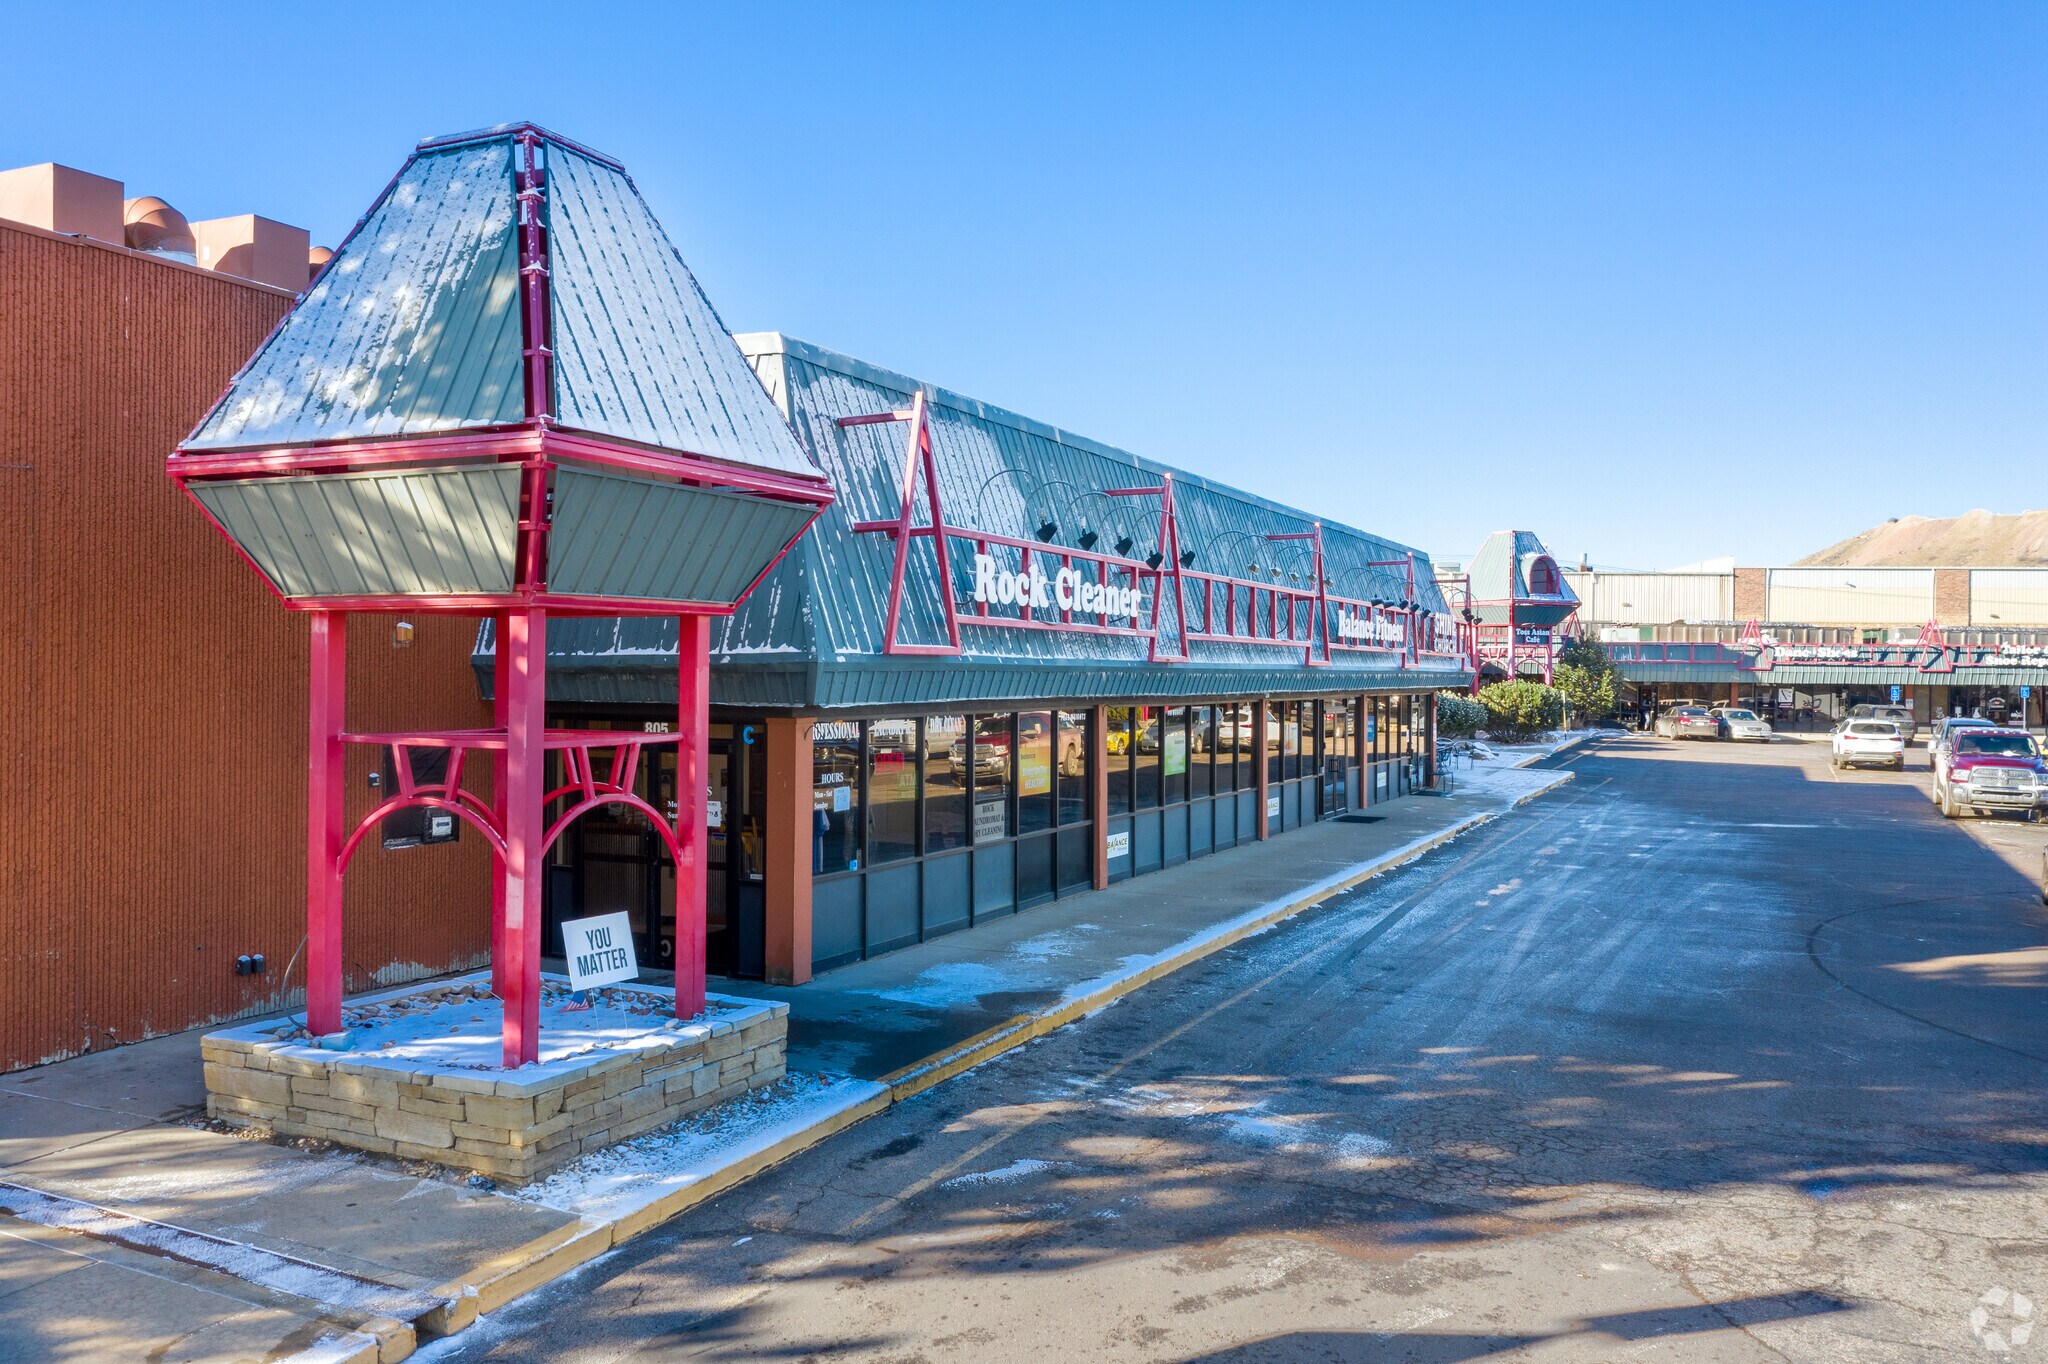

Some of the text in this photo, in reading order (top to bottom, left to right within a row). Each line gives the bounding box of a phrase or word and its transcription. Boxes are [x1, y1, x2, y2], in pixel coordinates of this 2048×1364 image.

[974, 553, 1141, 617] Rock Cleaner
[1338, 610, 1404, 642] Balance Fitness
[1531, 628, 1550, 636] Asian
[645, 722, 669, 733] 805
[821, 772, 844, 784] HOURS
[667, 800, 678, 808] Mo
[982, 804, 995, 813] ROCK
[982, 825, 1004, 836] CLEANING
[586, 927, 612, 951] YOU
[577, 948, 628, 977] MATTER
